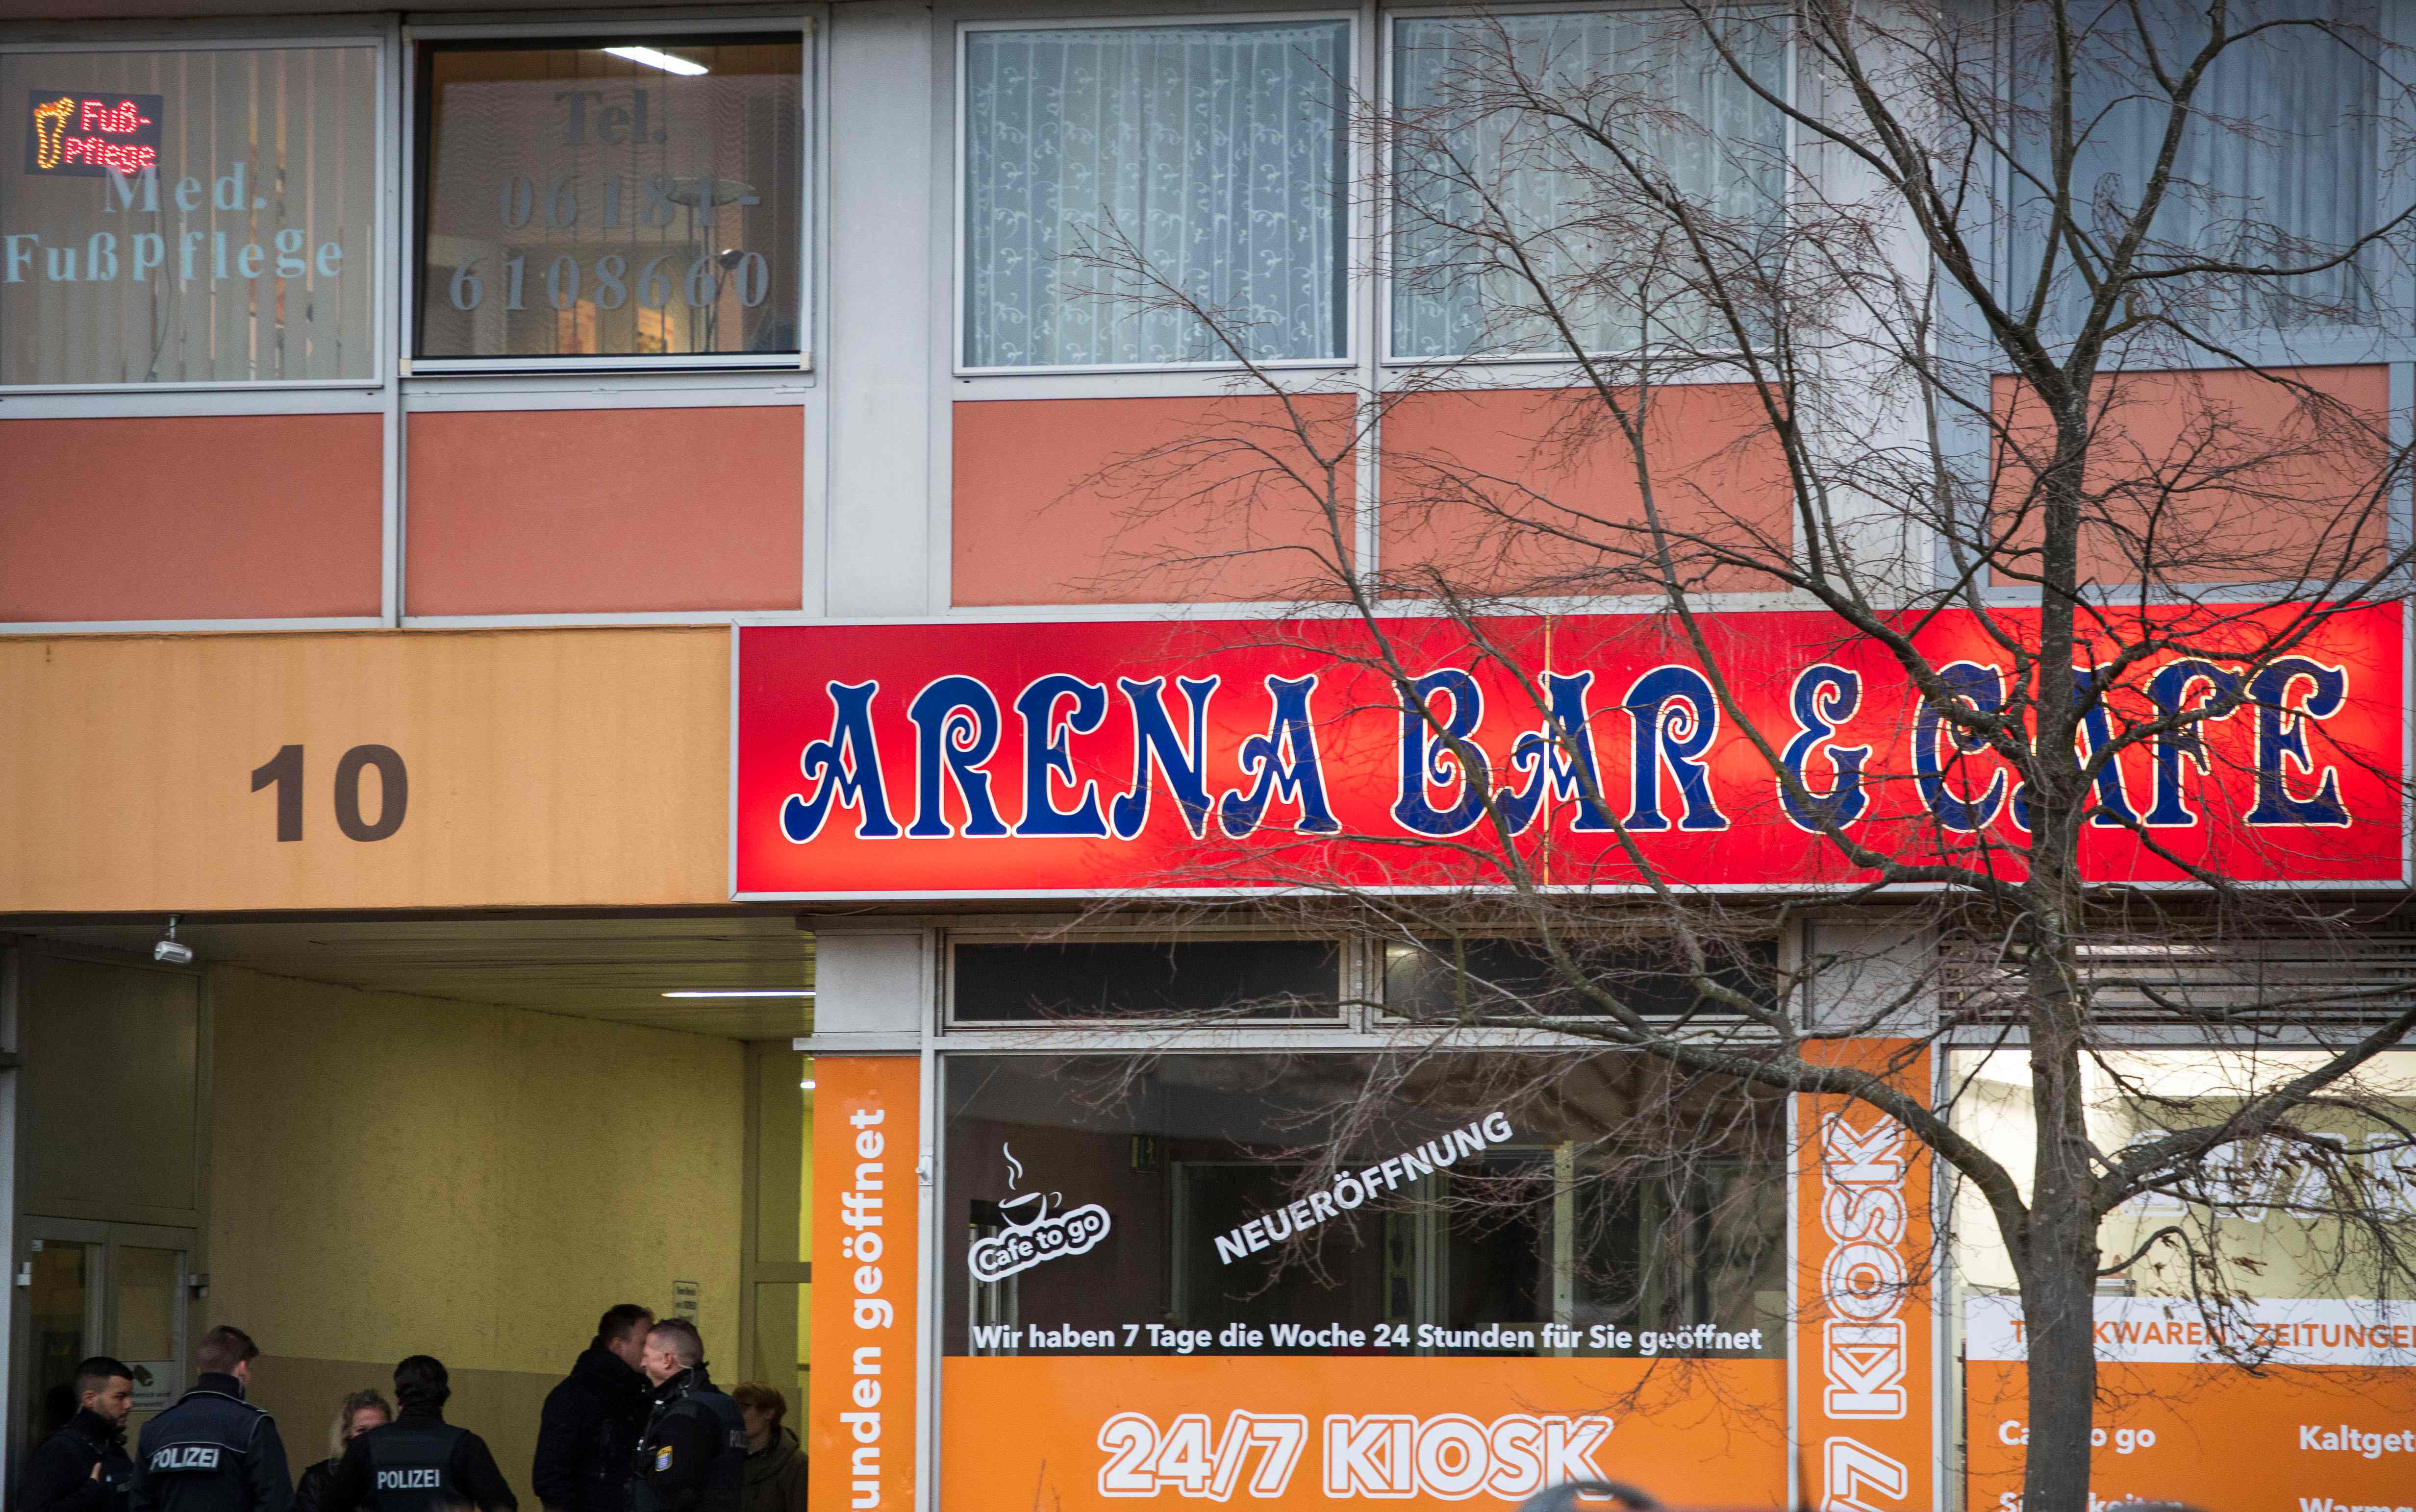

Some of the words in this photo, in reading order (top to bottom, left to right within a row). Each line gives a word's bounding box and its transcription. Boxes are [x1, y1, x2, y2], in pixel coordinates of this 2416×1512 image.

[81, 99, 151, 133] Fuß-
[555, 90, 667, 145] Tel.
[65, 136, 156, 174] Pflege
[103, 162, 267, 213] Med.
[2, 228, 343, 283] Fußpflege
[450, 252, 770, 311] 6108660
[780, 673, 1342, 843] ARENA
[1390, 665, 1731, 838] BAR
[1776, 664, 1872, 834] &
[251, 744, 408, 842] 10
[1214, 1112, 1513, 1265] NEUERÖFFNUNG
[842, 1109, 893, 1329] geöffnet
[979, 1238, 1034, 1270] Cafe
[1035, 1229, 1063, 1249] to
[1067, 1215, 1100, 1243] go
[1821, 1112, 1908, 1419] KIOSK
[973, 1324, 1023, 1349] Wir
[1030, 1323, 1114, 1348] haben
[1122, 1324, 1139, 1347] 7
[1145, 1324, 1212, 1354] Tage
[1219, 1323, 1263, 1347] die
[1270, 1322, 1366, 1348] Woche
[1373, 1324, 1410, 1347] 24
[1417, 1323, 1534, 1348] Stunden
[1540, 1323, 1583, 1348] für
[1589, 1324, 1632, 1349] Sie
[1639, 1325, 1762, 1356] geöffnet
[2010, 1320, 2226, 1346] TKWAREN
[149, 1447, 220, 1470] POLIZEI
[1098, 1410, 1308, 1503] 24/7
[1323, 1413, 1614, 1502] KIOSK
[2114, 1428, 2156, 1454] go
[377, 1469, 440, 1489] POLIZEI
